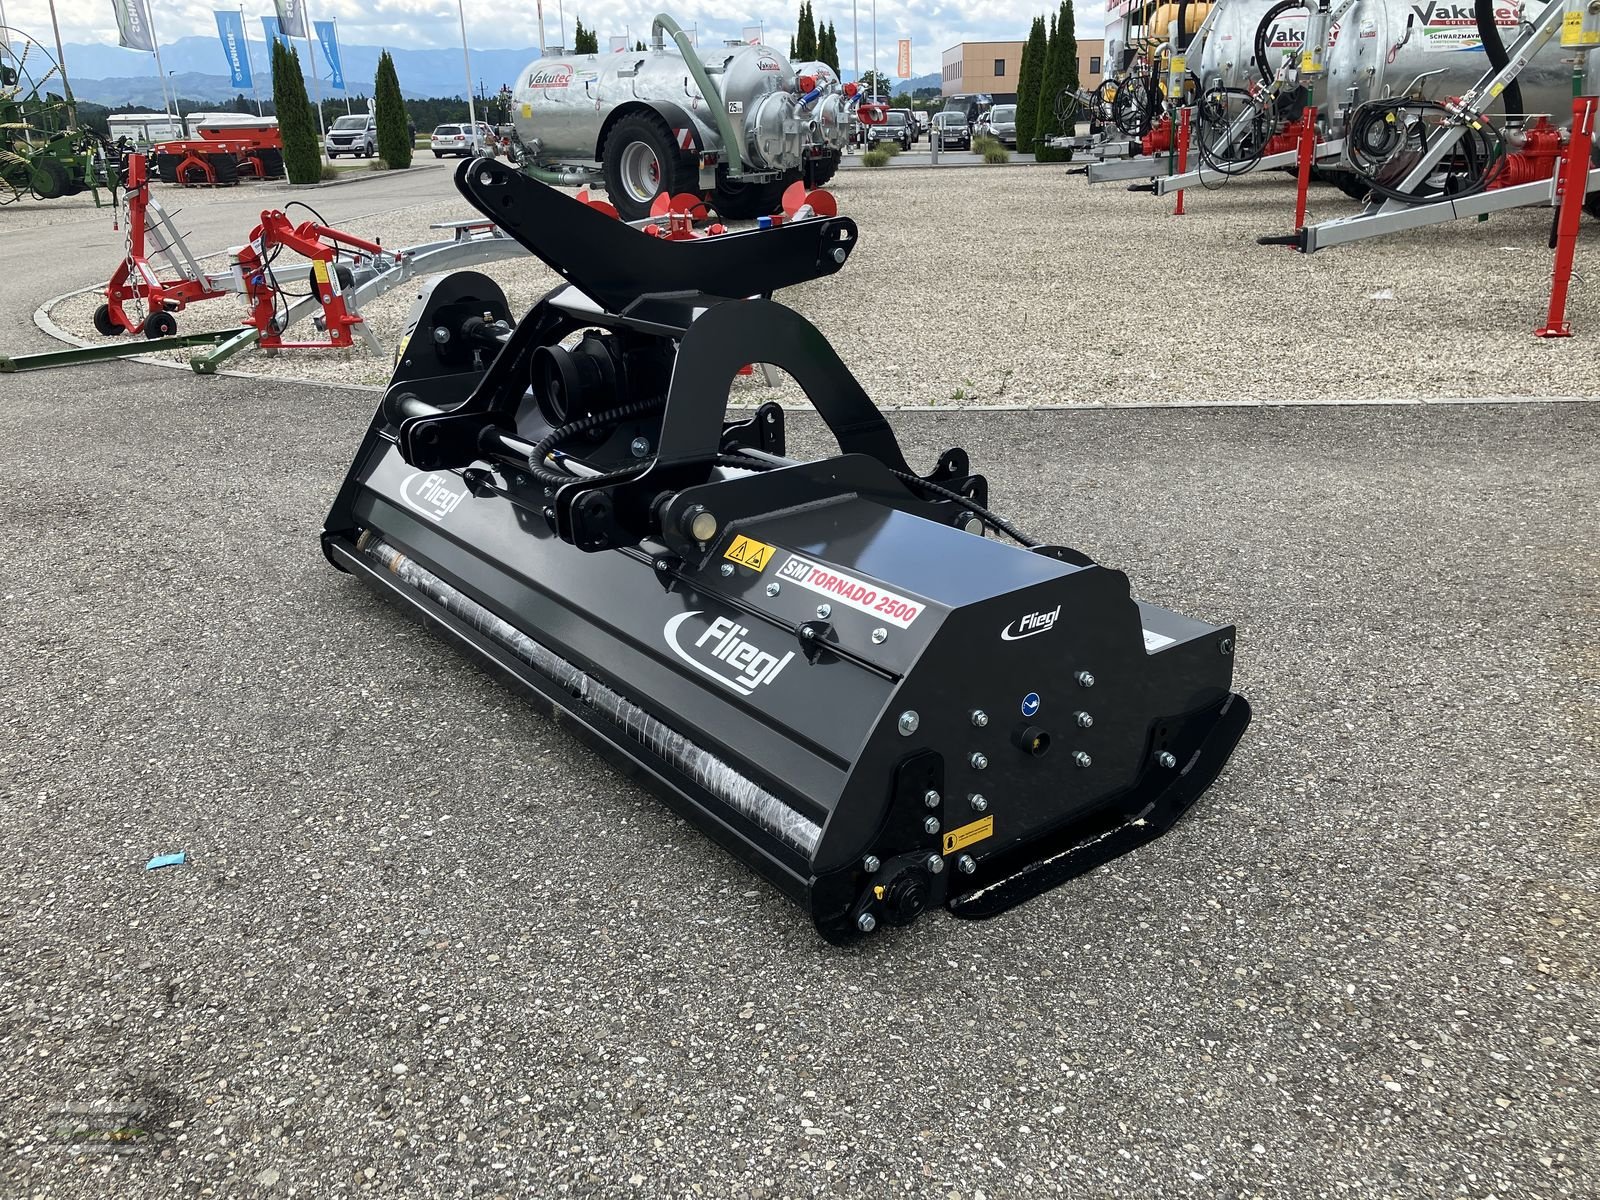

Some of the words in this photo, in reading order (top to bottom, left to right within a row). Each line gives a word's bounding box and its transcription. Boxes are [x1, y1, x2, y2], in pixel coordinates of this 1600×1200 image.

[528, 71, 572, 89] Vakutec
[729, 102, 737, 112] 25
[415, 473, 469, 517] Fliegl
[783, 559, 812, 580] SM
[807, 568, 877, 606] TORNADO
[874, 596, 917, 622] 2500
[1018, 604, 1061, 632] Fliegl
[694, 616, 796, 689] Fliegl
